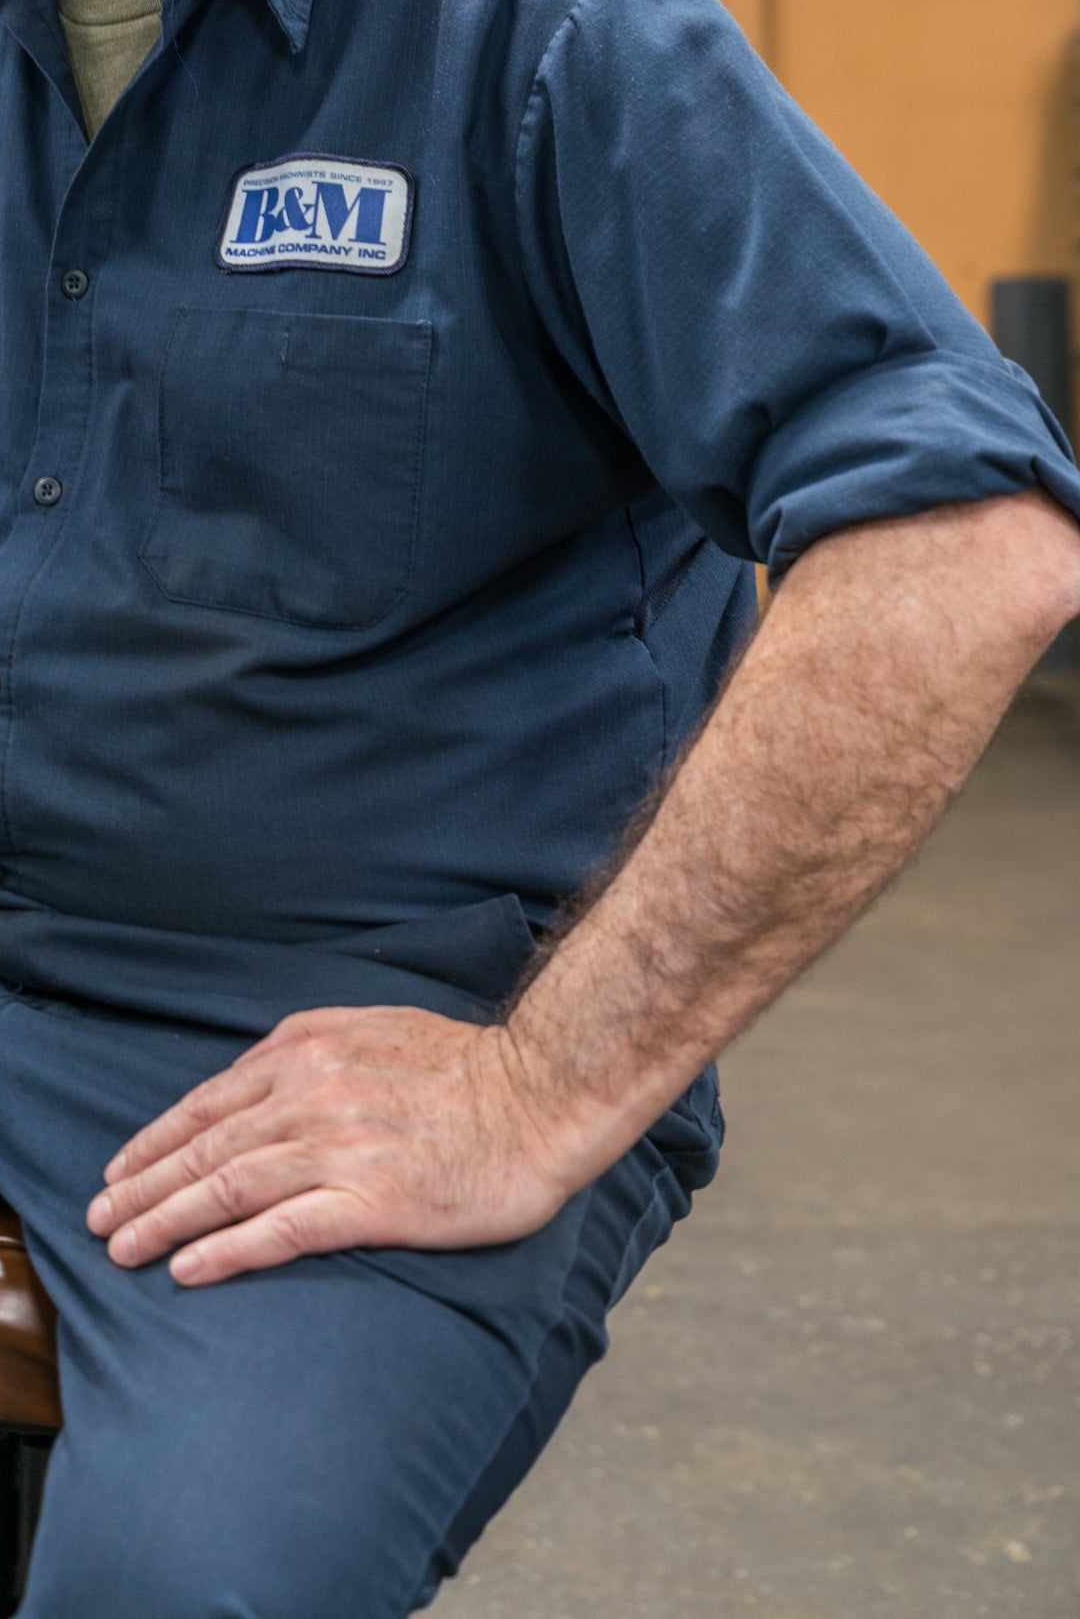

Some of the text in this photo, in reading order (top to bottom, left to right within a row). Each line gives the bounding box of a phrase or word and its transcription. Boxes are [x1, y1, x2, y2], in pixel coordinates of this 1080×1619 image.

[330, 172, 362, 183] SINCE
[367, 177, 394, 187] 1947
[229, 181, 393, 246] B&M
[225, 242, 387, 260] MACHINE COMPANY INC
